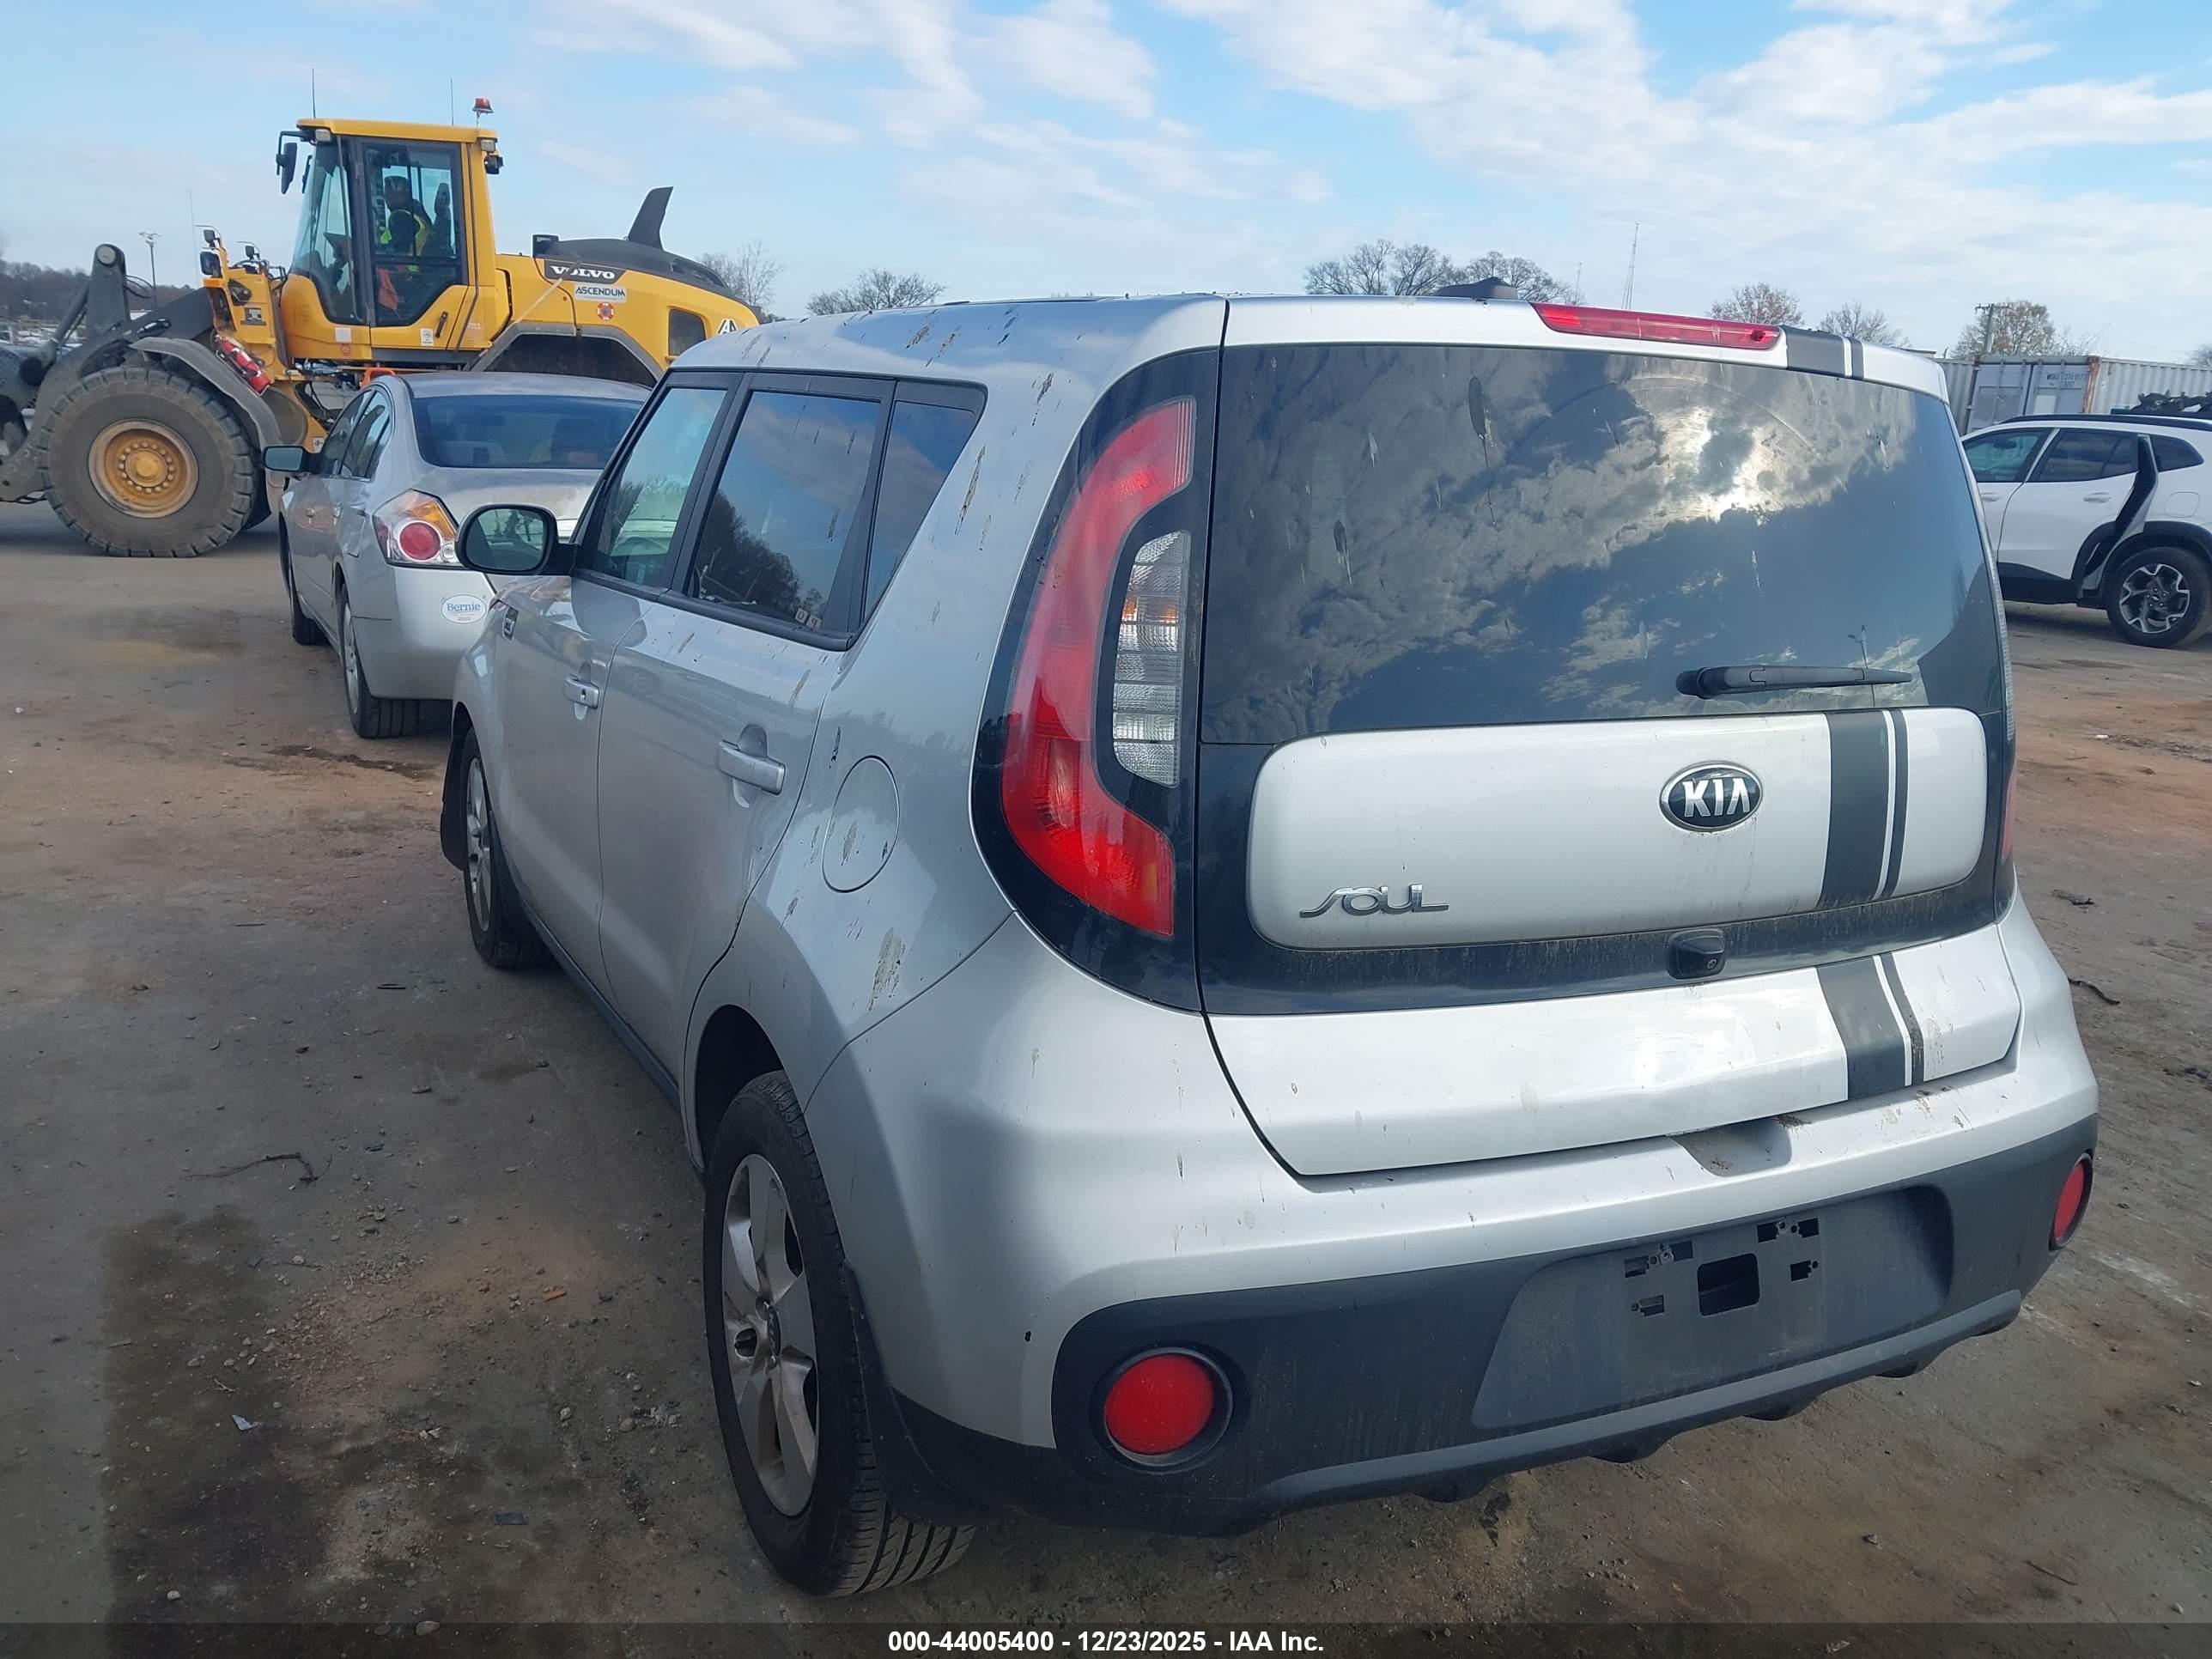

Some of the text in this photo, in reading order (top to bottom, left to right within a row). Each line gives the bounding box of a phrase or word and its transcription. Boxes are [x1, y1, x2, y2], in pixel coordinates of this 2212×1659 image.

[575, 286, 626, 297] ASCENDUM
[447, 602, 481, 611] Bernie
[1681, 777, 1751, 817] KIA
[1298, 883, 1449, 919] SOUL
